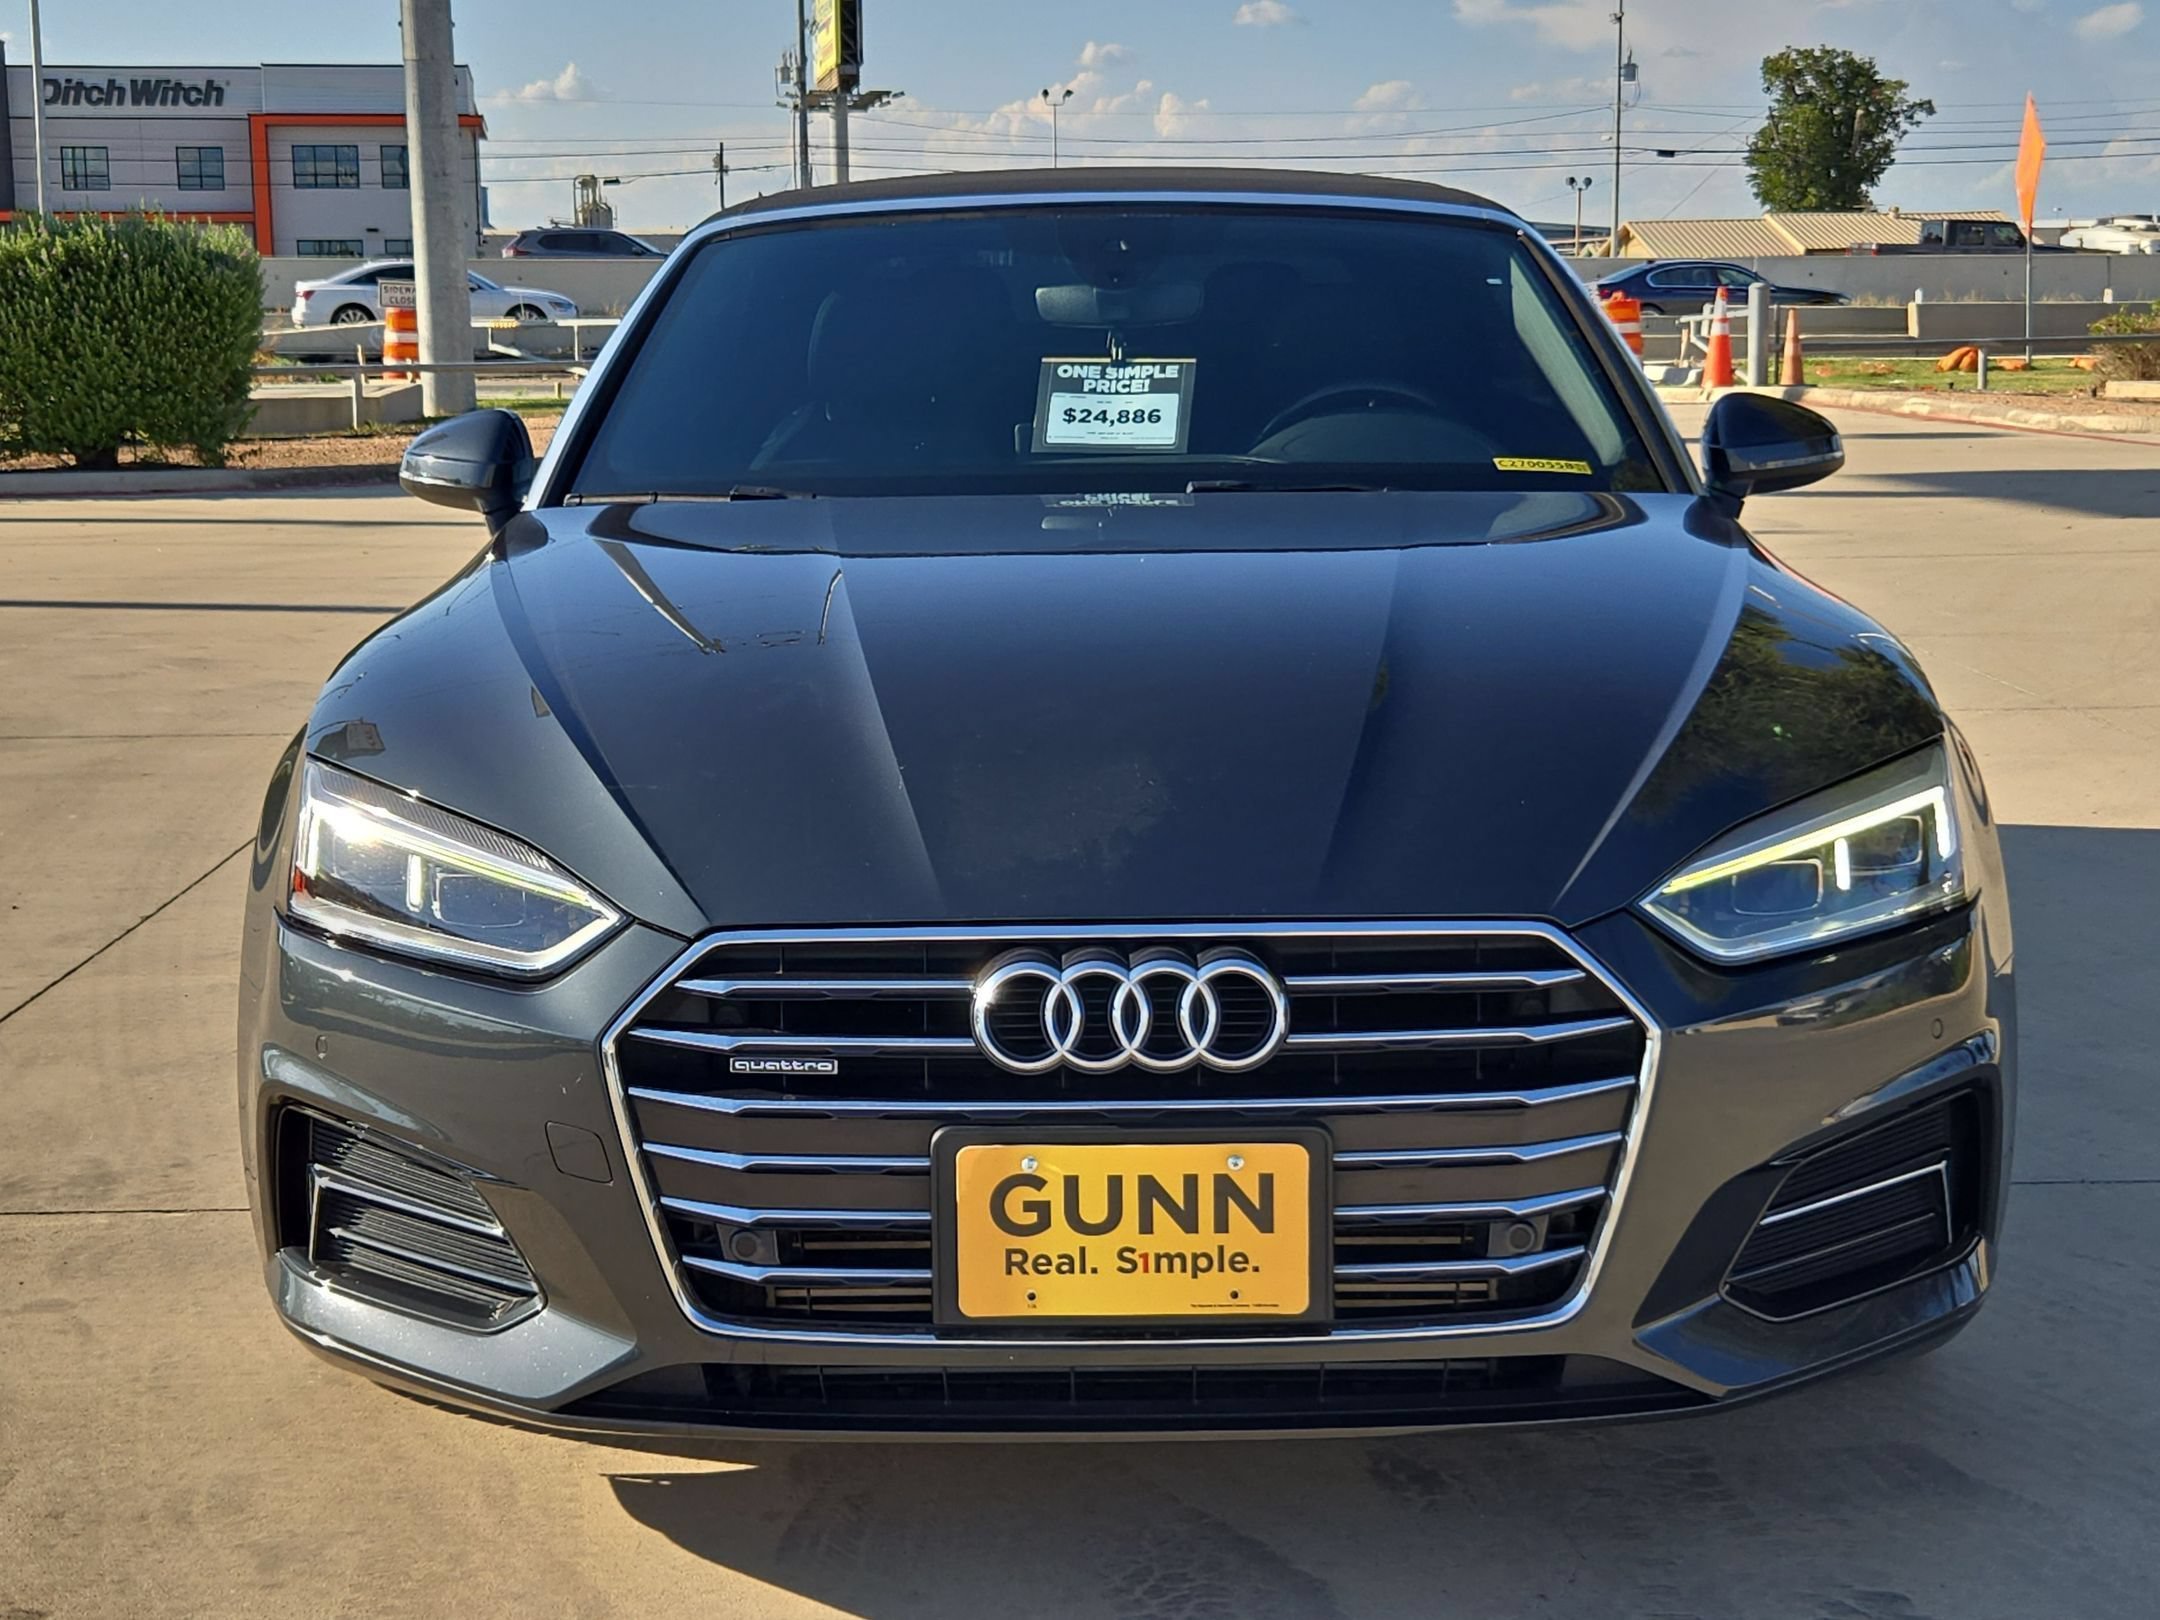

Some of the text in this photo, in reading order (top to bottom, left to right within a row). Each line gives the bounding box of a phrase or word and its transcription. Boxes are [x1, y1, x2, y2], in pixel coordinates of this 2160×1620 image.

[43, 78, 225, 107] Ditch Witch
[383, 285, 416, 294] SIDEWA
[389, 296, 416, 305] CLOSE
[1057, 364, 1180, 380] ONE SIMPLE
[1083, 379, 1151, 393] PRICE!
[1062, 407, 1162, 427] $24,886
[734, 1060, 833, 1072] quattro
[989, 1172, 1275, 1238] GUNN
[1004, 1246, 1099, 1276] Real.
